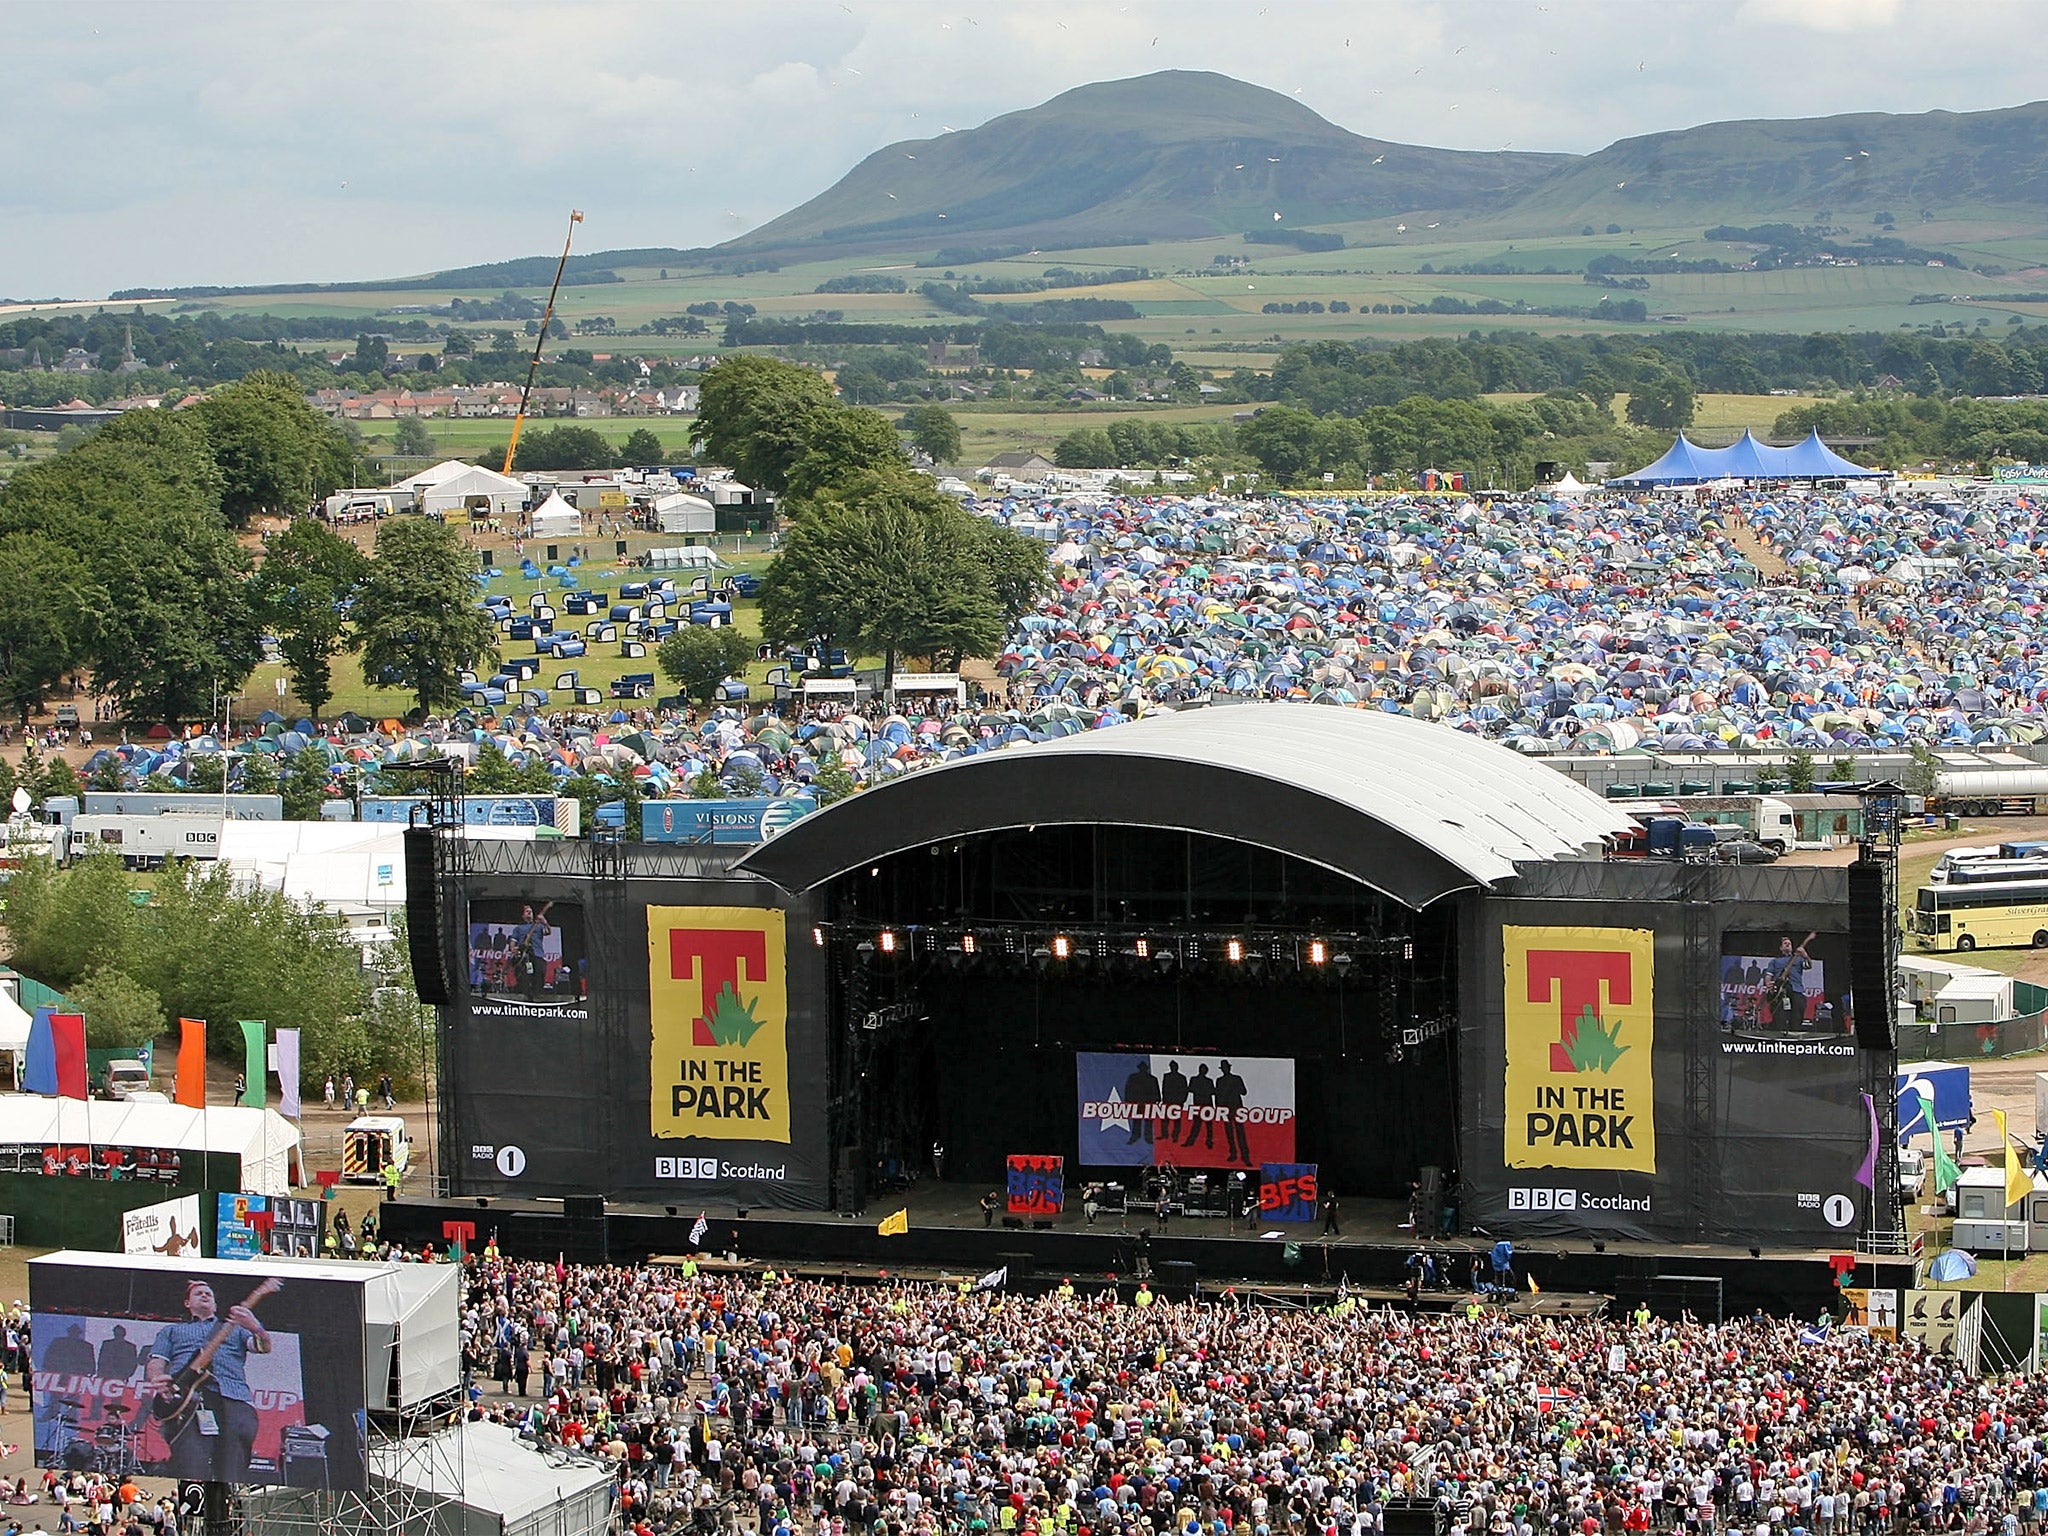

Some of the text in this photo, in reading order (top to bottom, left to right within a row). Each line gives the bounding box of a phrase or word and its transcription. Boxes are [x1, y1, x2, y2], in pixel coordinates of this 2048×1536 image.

[696, 813, 756, 825] VISIONS
[186, 832, 217, 842] BBC
[669, 928, 767, 1047] T
[471, 1004, 588, 1019] www.tinthepark.com
[1526, 949, 1632, 1072] T
[1722, 1041, 1855, 1056] www.tinthepark.com
[680, 1060, 762, 1083] IN THE
[671, 1085, 771, 1120] PARK
[1536, 1086, 1625, 1111] IN THE
[1082, 1102, 1293, 1125] BOWLING FOR SOUP
[1527, 1113, 1634, 1149] PARK
[655, 1157, 785, 1180] BBC Scotland
[1260, 1175, 1315, 1210] BFS
[1508, 1188, 1651, 1212] BBC Scotland
[1797, 1193, 1820, 1202] BBC
[1797, 1201, 1821, 1209] RADIO
[126, 1215, 159, 1236] Fratellis
